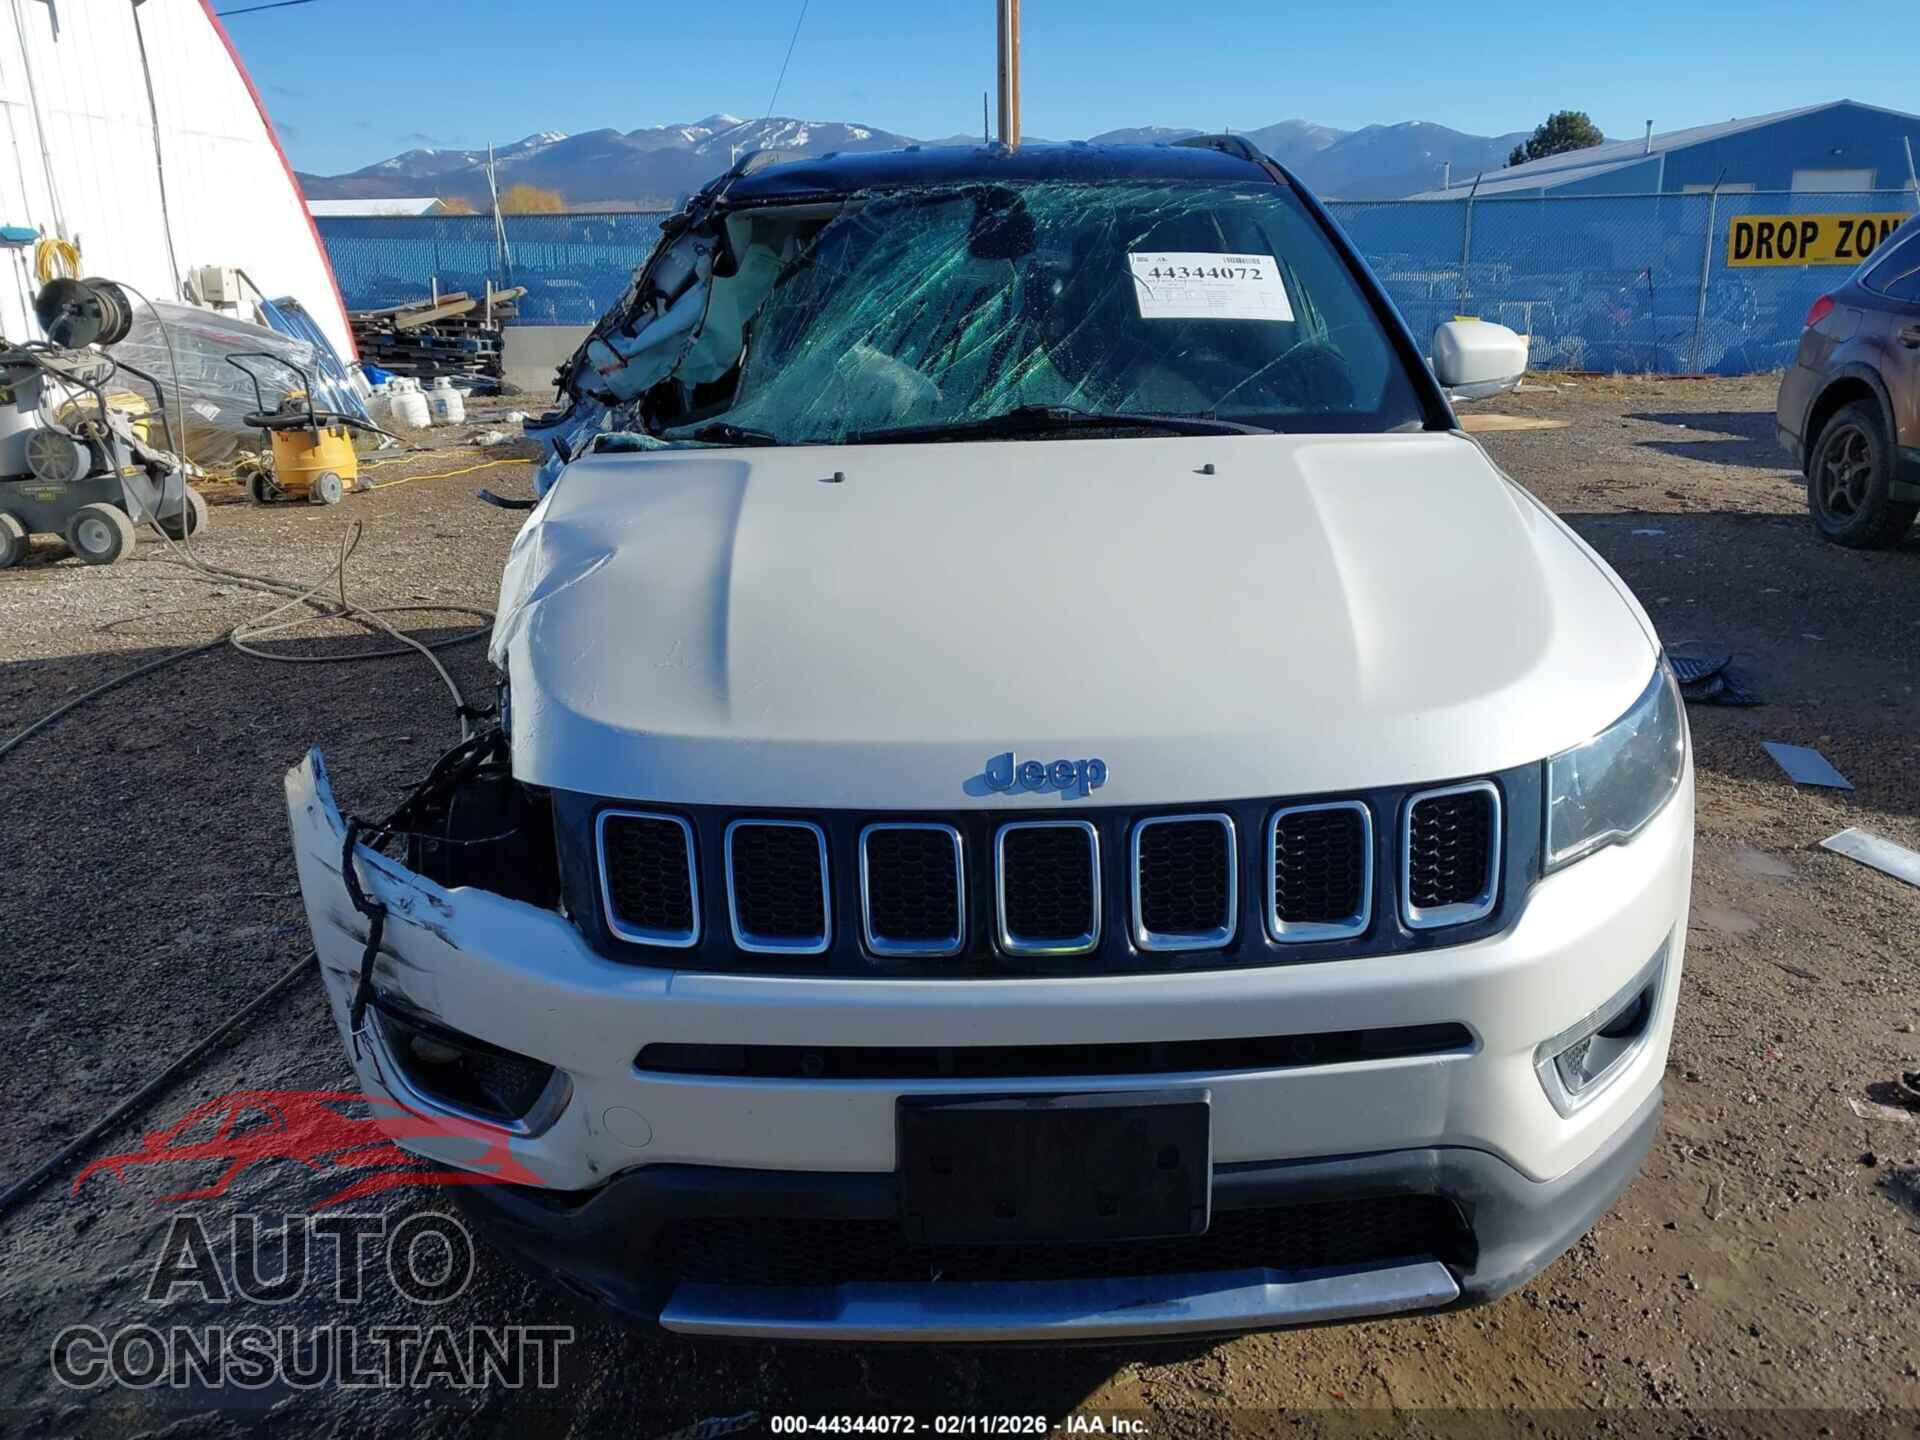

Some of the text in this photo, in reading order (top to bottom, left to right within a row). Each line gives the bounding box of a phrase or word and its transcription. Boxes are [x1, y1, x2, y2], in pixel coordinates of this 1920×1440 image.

[1734, 219, 1905, 260] DROP ZON
[1149, 266, 1263, 281] 44344072
[984, 752, 1108, 797] Jeep
